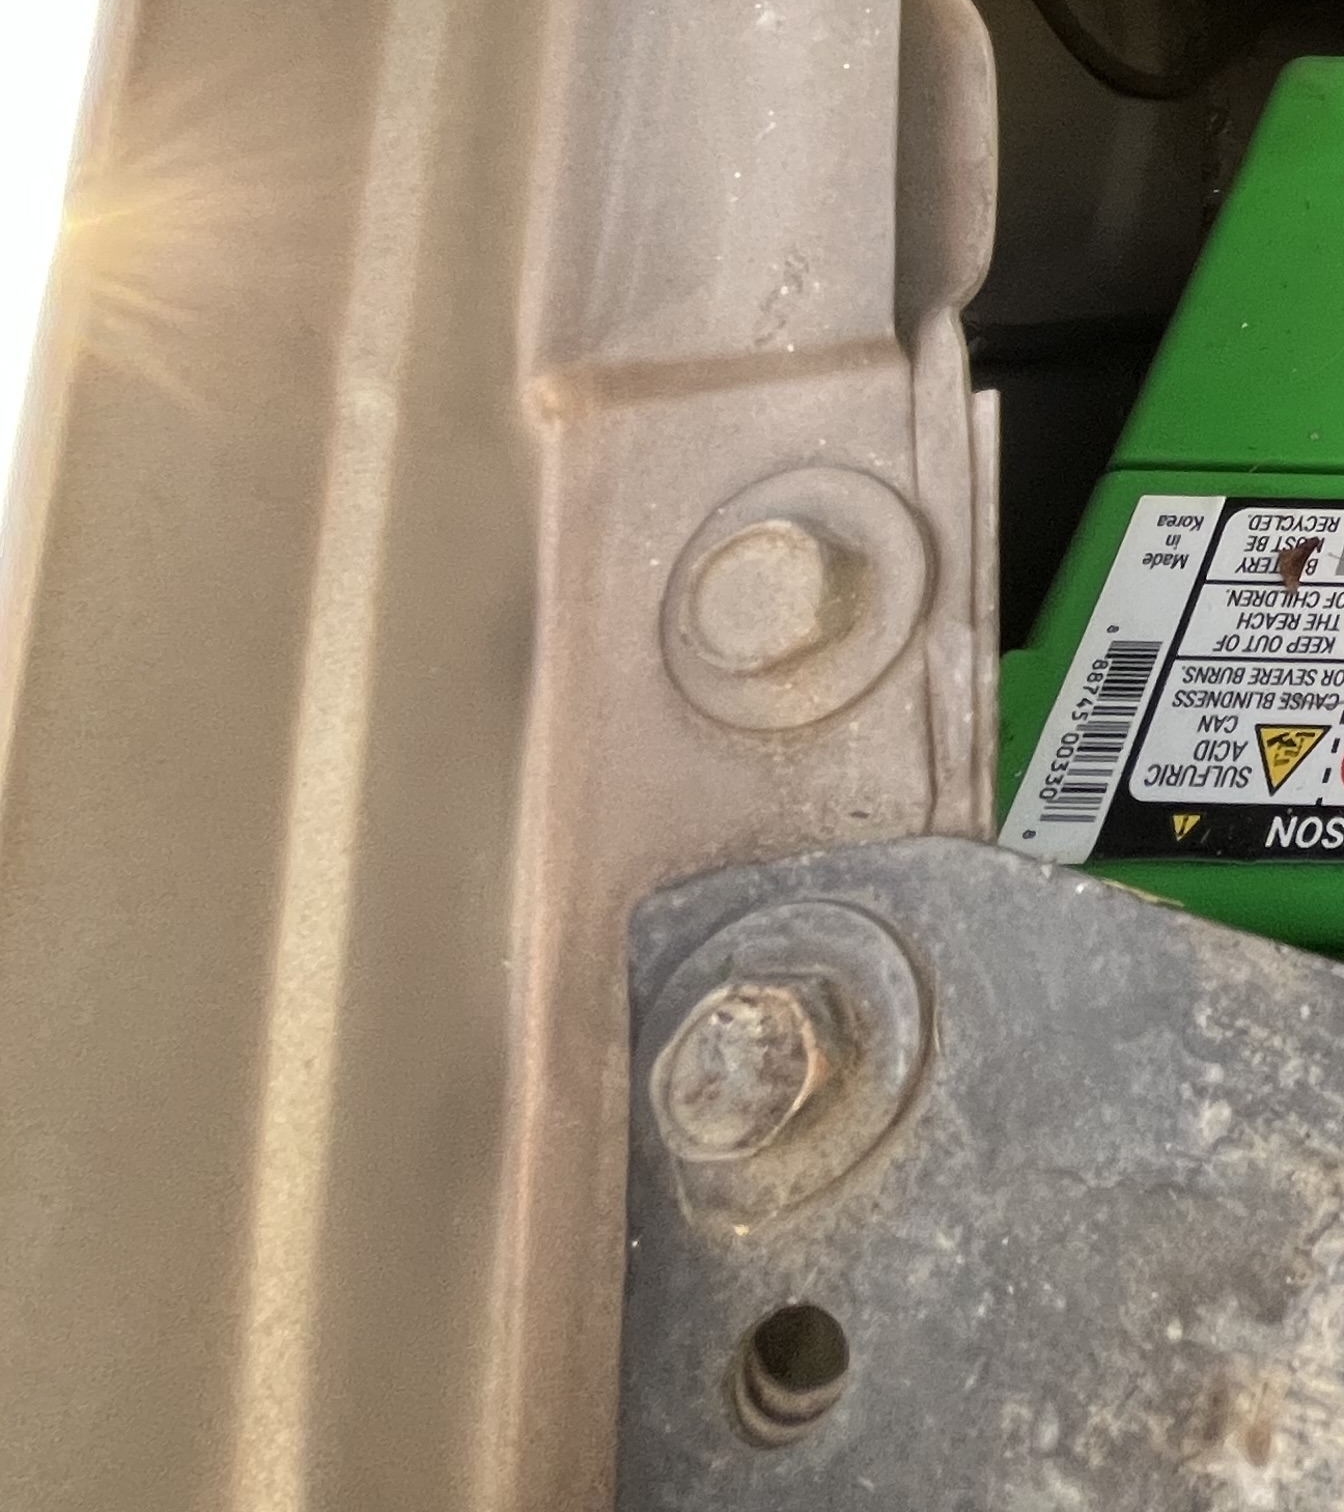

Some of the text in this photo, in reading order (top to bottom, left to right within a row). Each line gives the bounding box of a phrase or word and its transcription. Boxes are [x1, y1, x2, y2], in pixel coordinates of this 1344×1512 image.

[1156, 514, 1205, 532] Korea
[1247, 514, 1341, 532] RECYCLED.
[1165, 534, 1182, 551] in
[1243, 535, 1270, 552] BE
[1142, 552, 1190, 570] Made
[1226, 589, 1320, 608] CHILDREN.
[1235, 612, 1341, 631] THE REACH
[1212, 634, 1336, 654] KEEP OUT OF
[1181, 665, 1246, 685] BURNS.
[1247, 667, 1318, 686] SEVERE
[1171, 689, 1340, 711] CAUSE BLINDNESS
[1038, 659, 1109, 800] 88745 00330
[1197, 714, 1239, 734] CAN
[1193, 740, 1249, 762] ACID
[1143, 764, 1252, 789] SULFURIC
